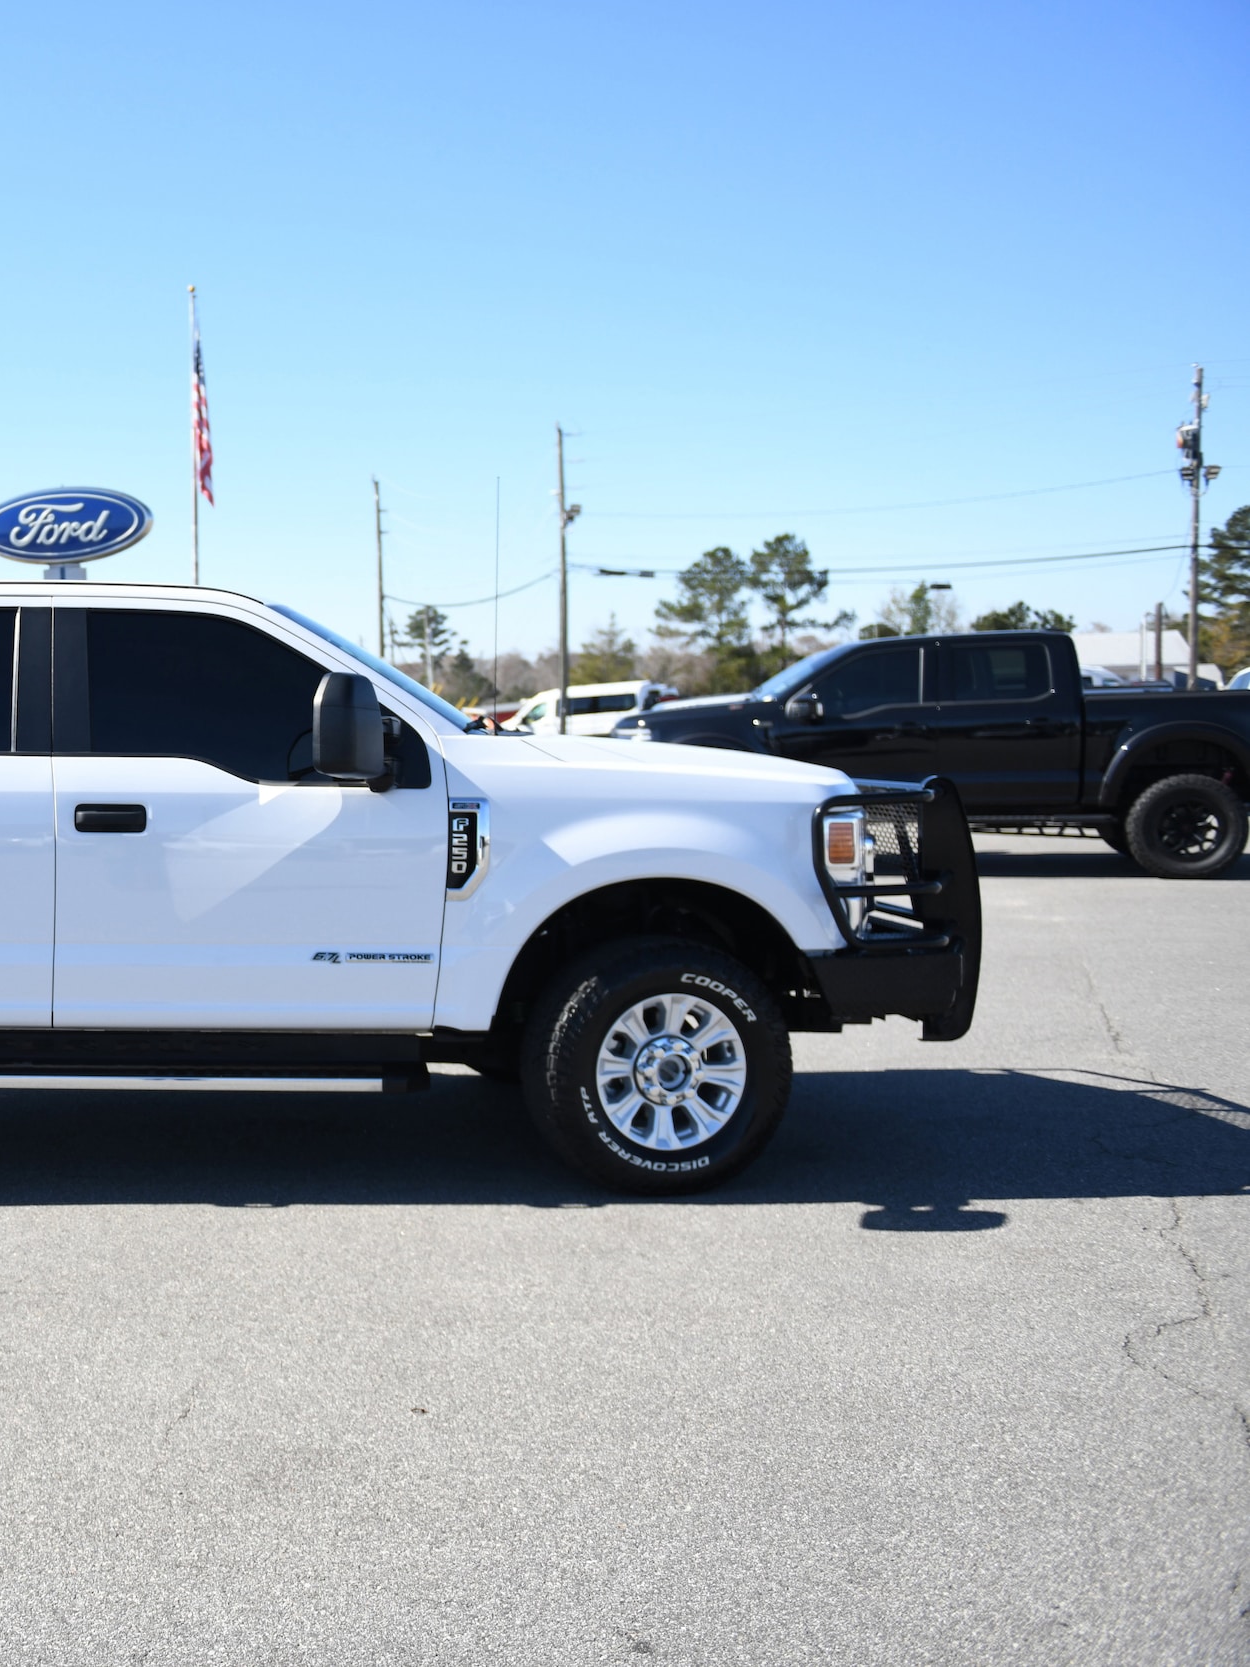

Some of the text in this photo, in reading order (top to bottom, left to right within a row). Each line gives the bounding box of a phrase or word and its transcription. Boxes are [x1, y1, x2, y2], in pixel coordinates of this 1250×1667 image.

[9, 502, 111, 547] Ford
[451, 817, 469, 873] F250
[680, 973, 757, 1022] COOPER
[580, 1086, 710, 1172] DISCOVERER ATP
